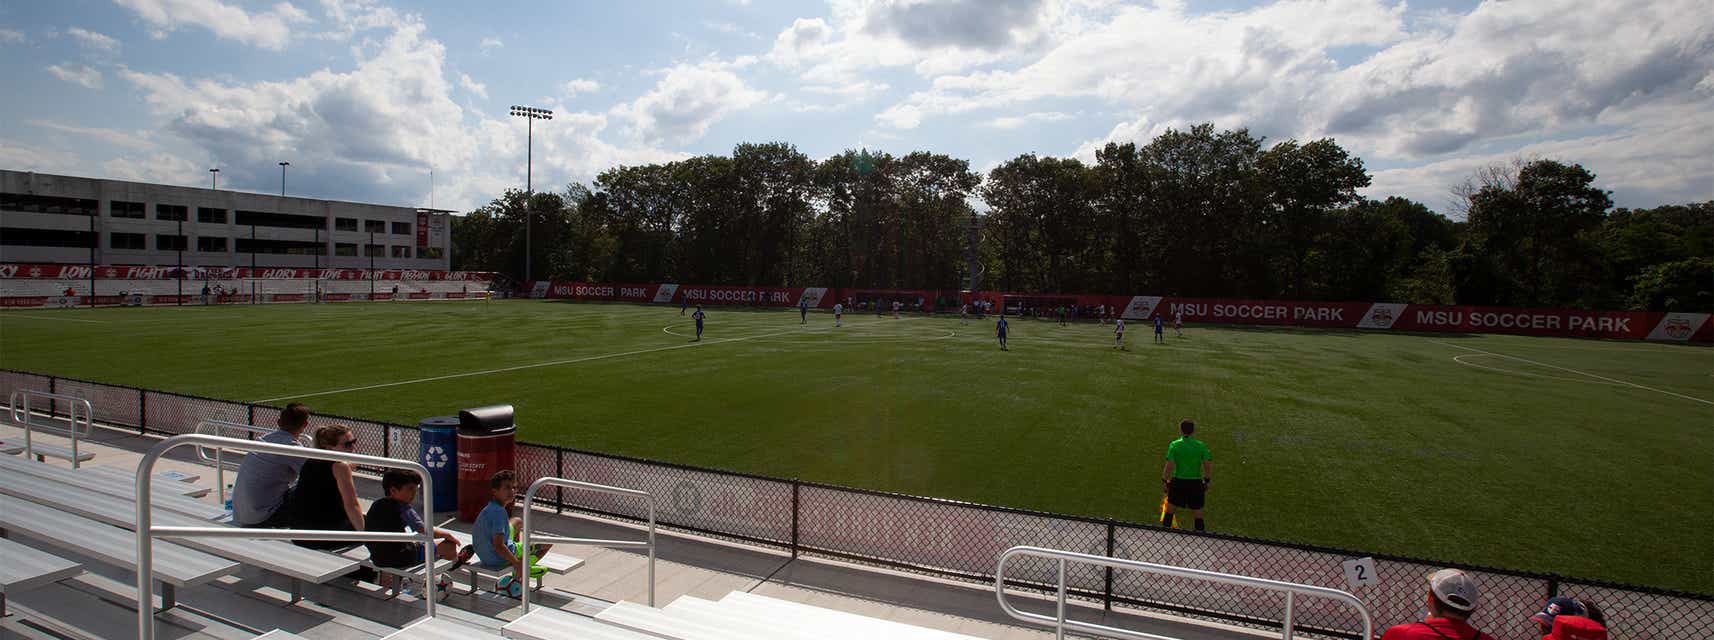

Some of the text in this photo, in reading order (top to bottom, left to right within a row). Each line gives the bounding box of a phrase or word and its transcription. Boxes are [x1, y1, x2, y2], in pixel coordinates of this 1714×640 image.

[127, 267, 167, 279] FIGHT
[262, 269, 297, 279] GLORY
[319, 270, 342, 280] LOVE
[554, 286, 647, 297] MSU SOCCER PARK
[683, 289, 707, 300] MSU
[710, 289, 756, 302] SOCCER
[1169, 303, 1344, 321] MSU SOCCER PARK
[1416, 311, 1632, 333] MSU SOCCER PARK
[1355, 565, 1368, 580] 2
